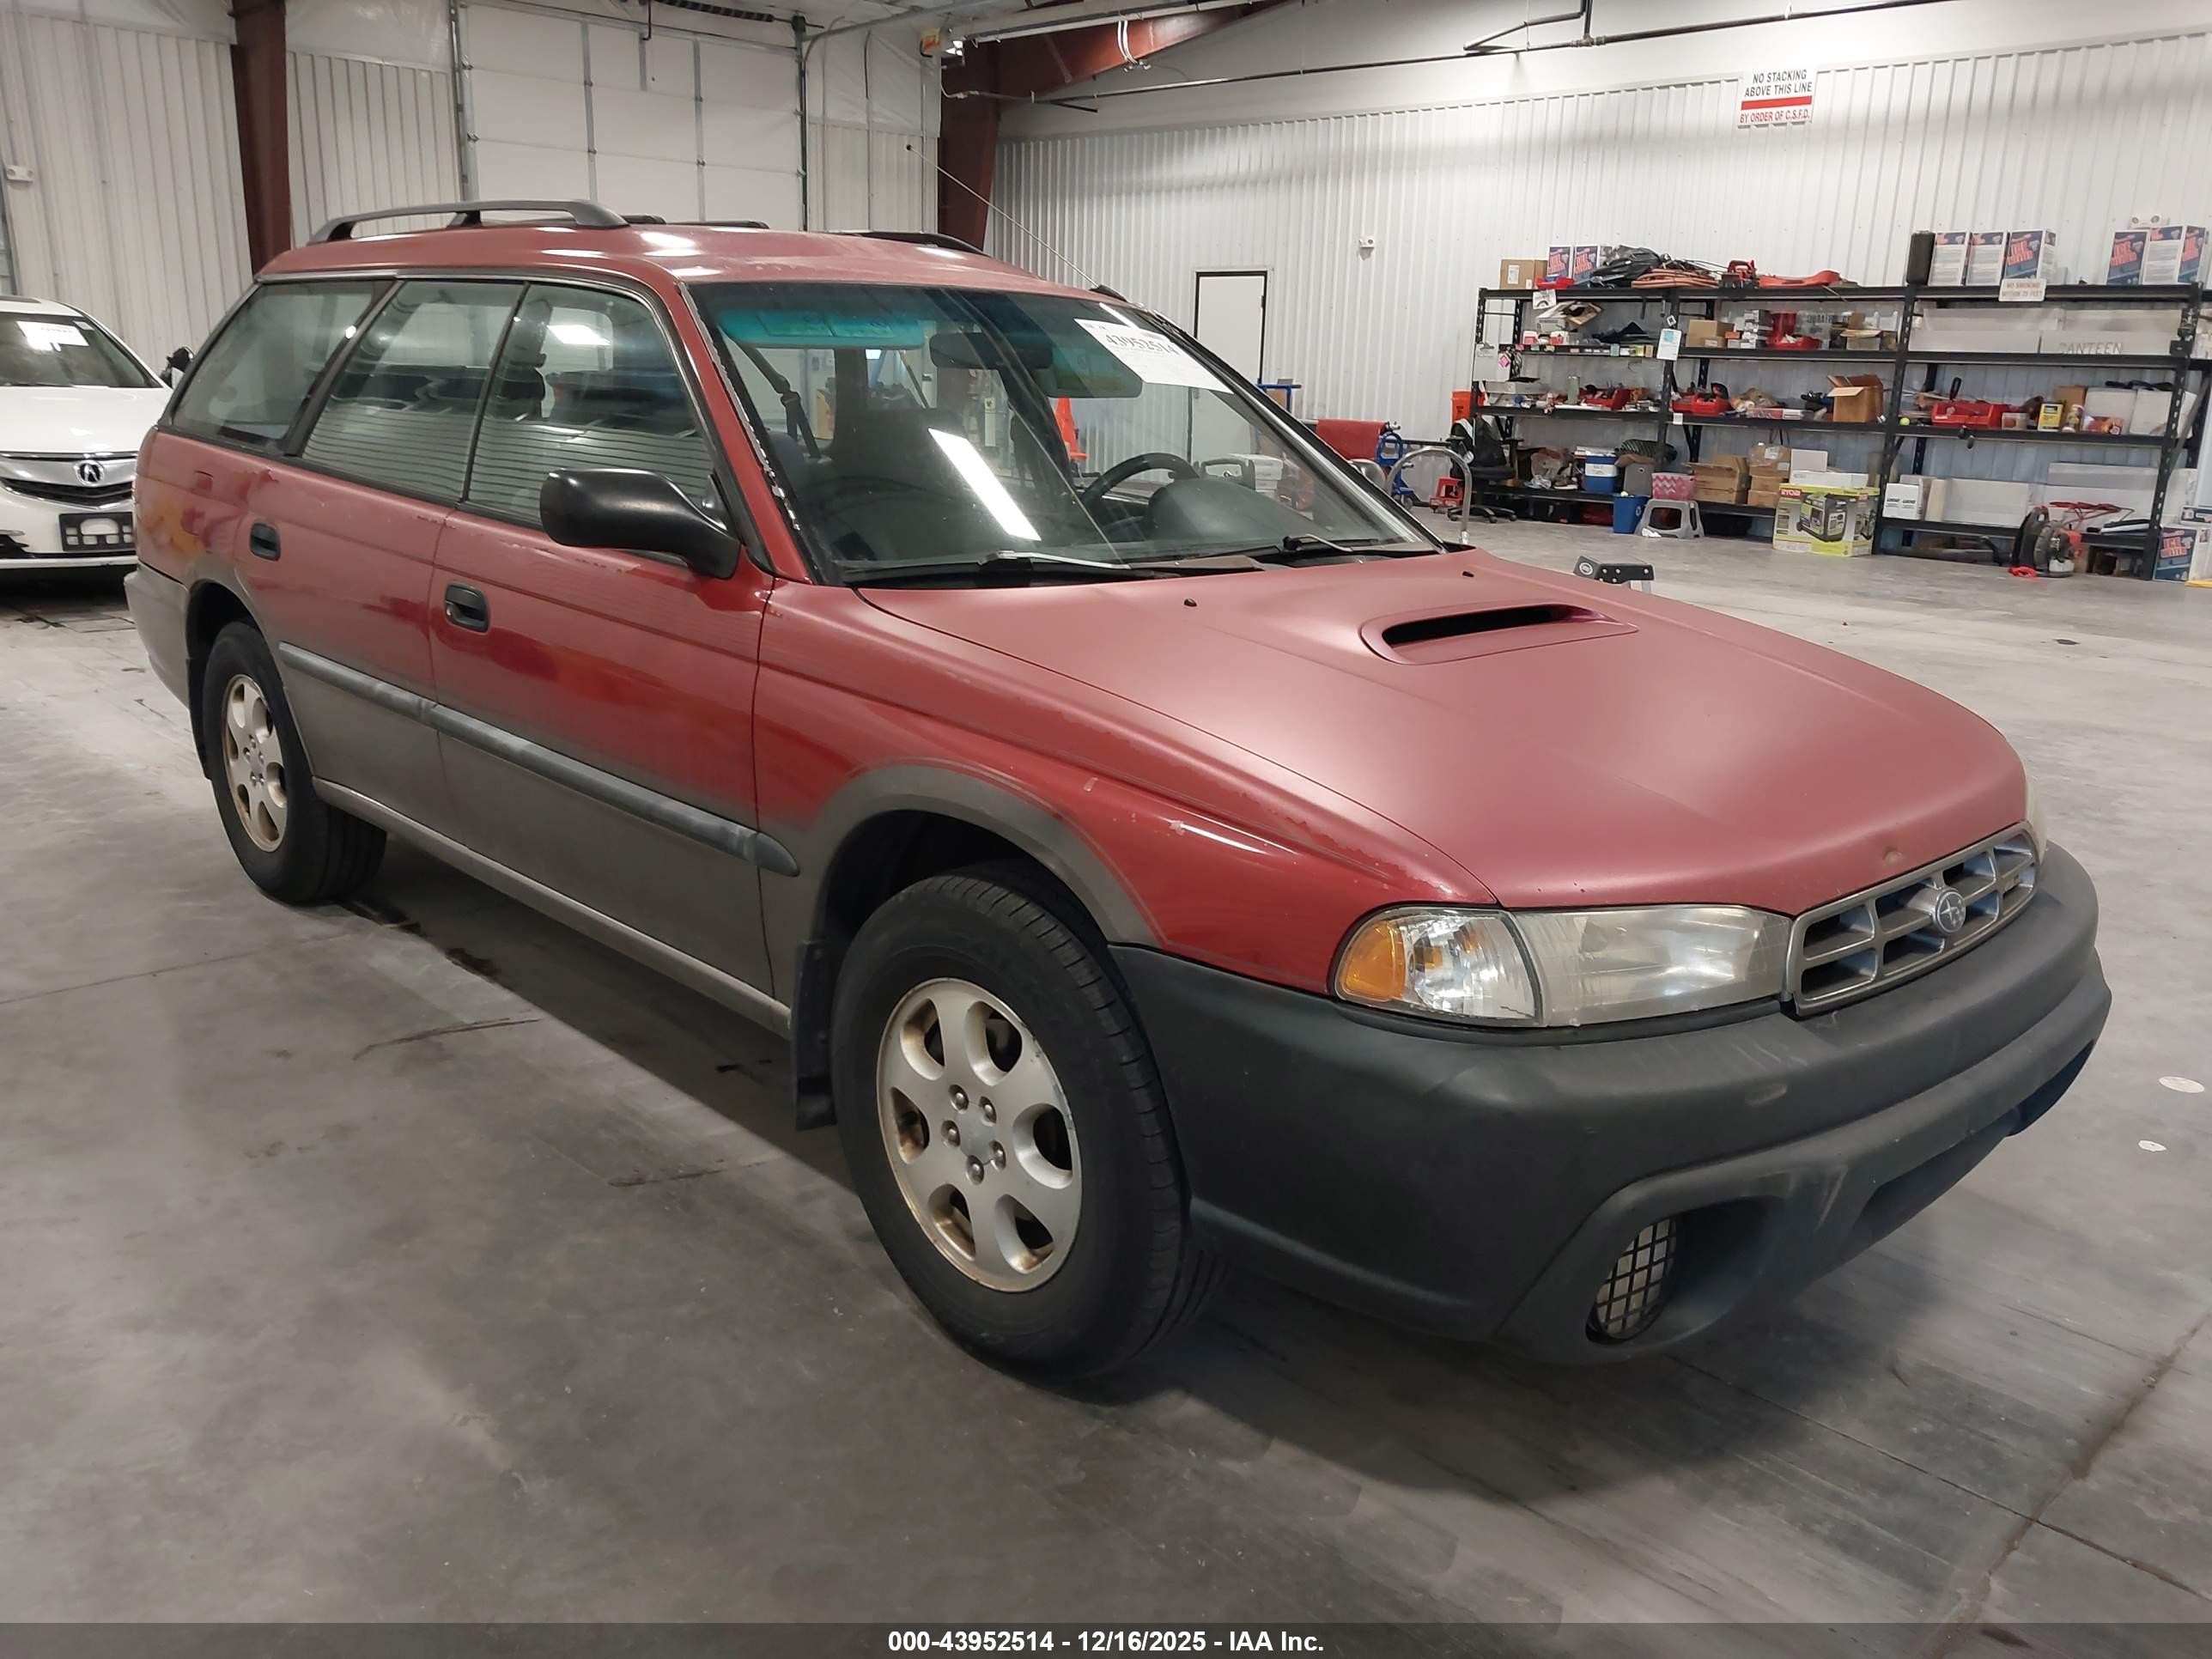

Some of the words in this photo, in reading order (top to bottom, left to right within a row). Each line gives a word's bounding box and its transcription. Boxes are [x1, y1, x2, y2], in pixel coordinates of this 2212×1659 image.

[1753, 73, 1765, 83] NO
[1766, 70, 1807, 82] STACKING
[1745, 85, 1771, 97] ABOVE
[1774, 83, 1792, 94] THIS
[1794, 82, 1813, 93] LINE
[1740, 112, 1749, 123] BY
[1751, 112, 1773, 122] ORDER
[1775, 110, 1784, 120] OF
